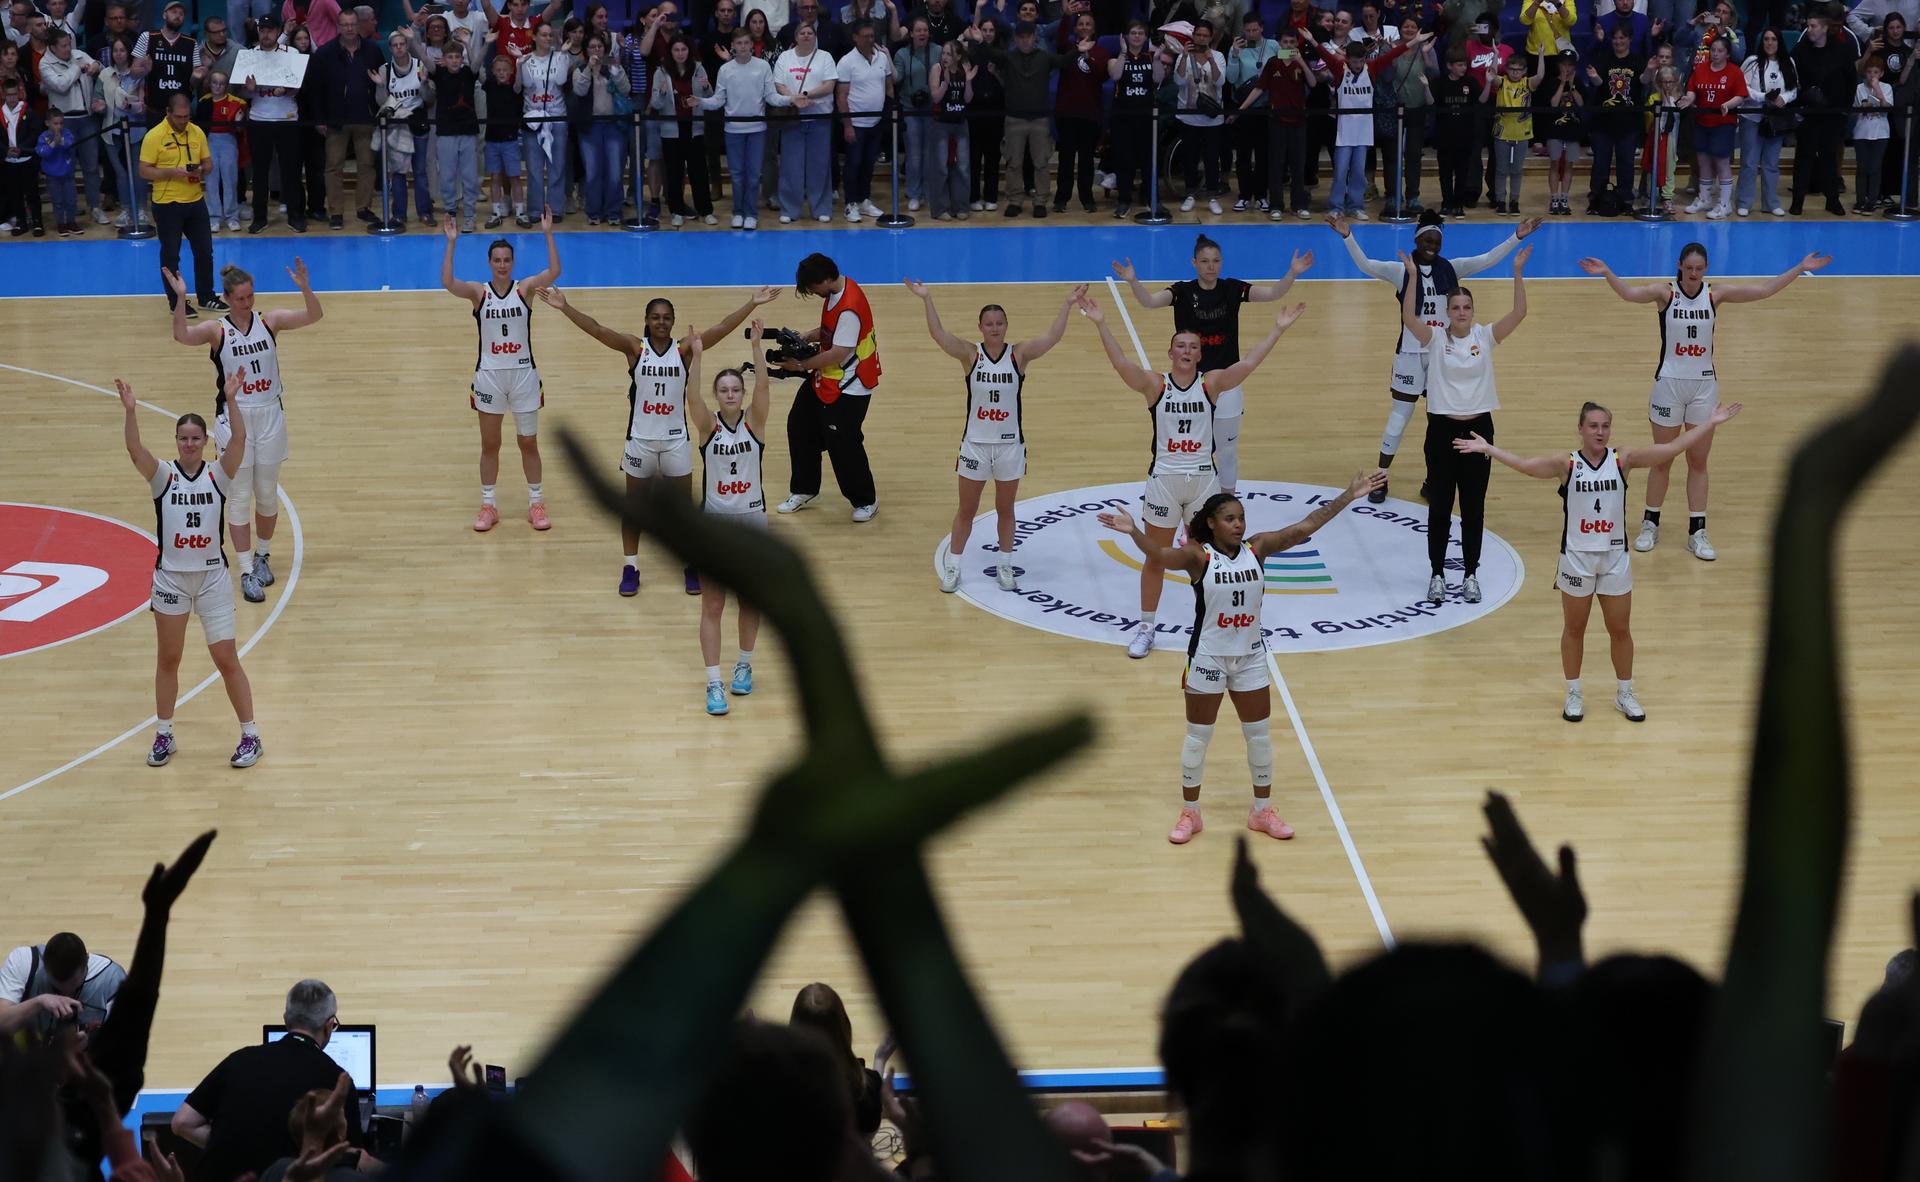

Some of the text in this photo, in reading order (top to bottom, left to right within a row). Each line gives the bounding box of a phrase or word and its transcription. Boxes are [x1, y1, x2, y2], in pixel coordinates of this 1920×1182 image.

[155, 53, 187, 63] BELGIUM
[167, 64, 174, 76] 11
[1124, 63, 1152, 71] ELGIUM
[1131, 73, 1143, 83] 55
[1706, 90, 1716, 103] 15
[485, 306, 523, 319] BELGIUM
[1423, 302, 1436, 315] 22
[1673, 308, 1710, 320] BELGIUM
[501, 323, 508, 337] 6
[1686, 325, 1697, 339] 16
[232, 340, 269, 357] BELGIUM
[250, 359, 261, 375] 11
[641, 365, 680, 377] BELGIUM
[976, 371, 1013, 384] BELGIUM
[654, 382, 666, 396] 71
[988, 390, 1000, 403] 15
[1164, 401, 1205, 413] BELGIUM
[1177, 419, 1192, 434] 27
[713, 440, 752, 456] BELGIUM
[730, 461, 737, 475] 2
[1575, 479, 1617, 493] BELGIUM
[171, 492, 214, 506] BELGIUM
[1593, 498, 1602, 514] 4
[186, 512, 201, 528] 25
[1351, 506, 1463, 546] cancr
[1214, 568, 1259, 585] BELGIUM
[1232, 590, 1245, 607] 31
[1012, 587, 1142, 632] kanker
